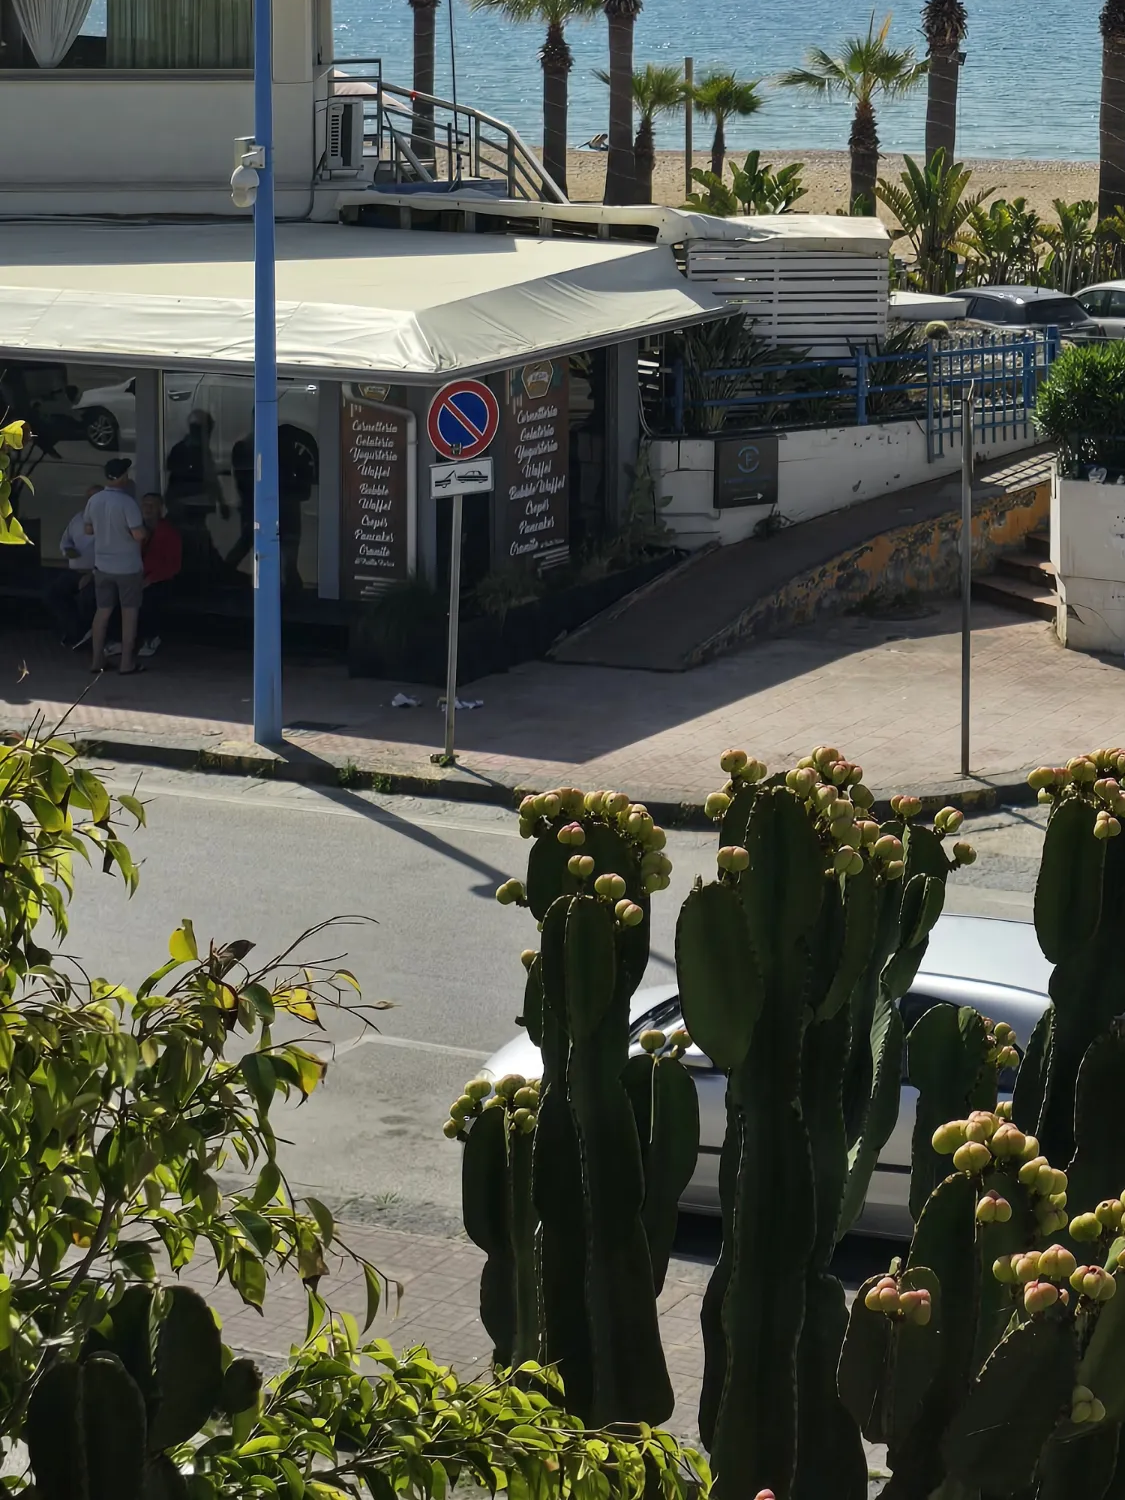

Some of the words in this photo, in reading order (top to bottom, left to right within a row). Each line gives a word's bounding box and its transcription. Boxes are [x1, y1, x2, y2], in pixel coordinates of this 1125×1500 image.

[359, 483, 389, 496] Bubble
[509, 482, 536, 500] Bubble
[519, 516, 555, 535] Pancakes
[354, 529, 394, 543] Pancakes
